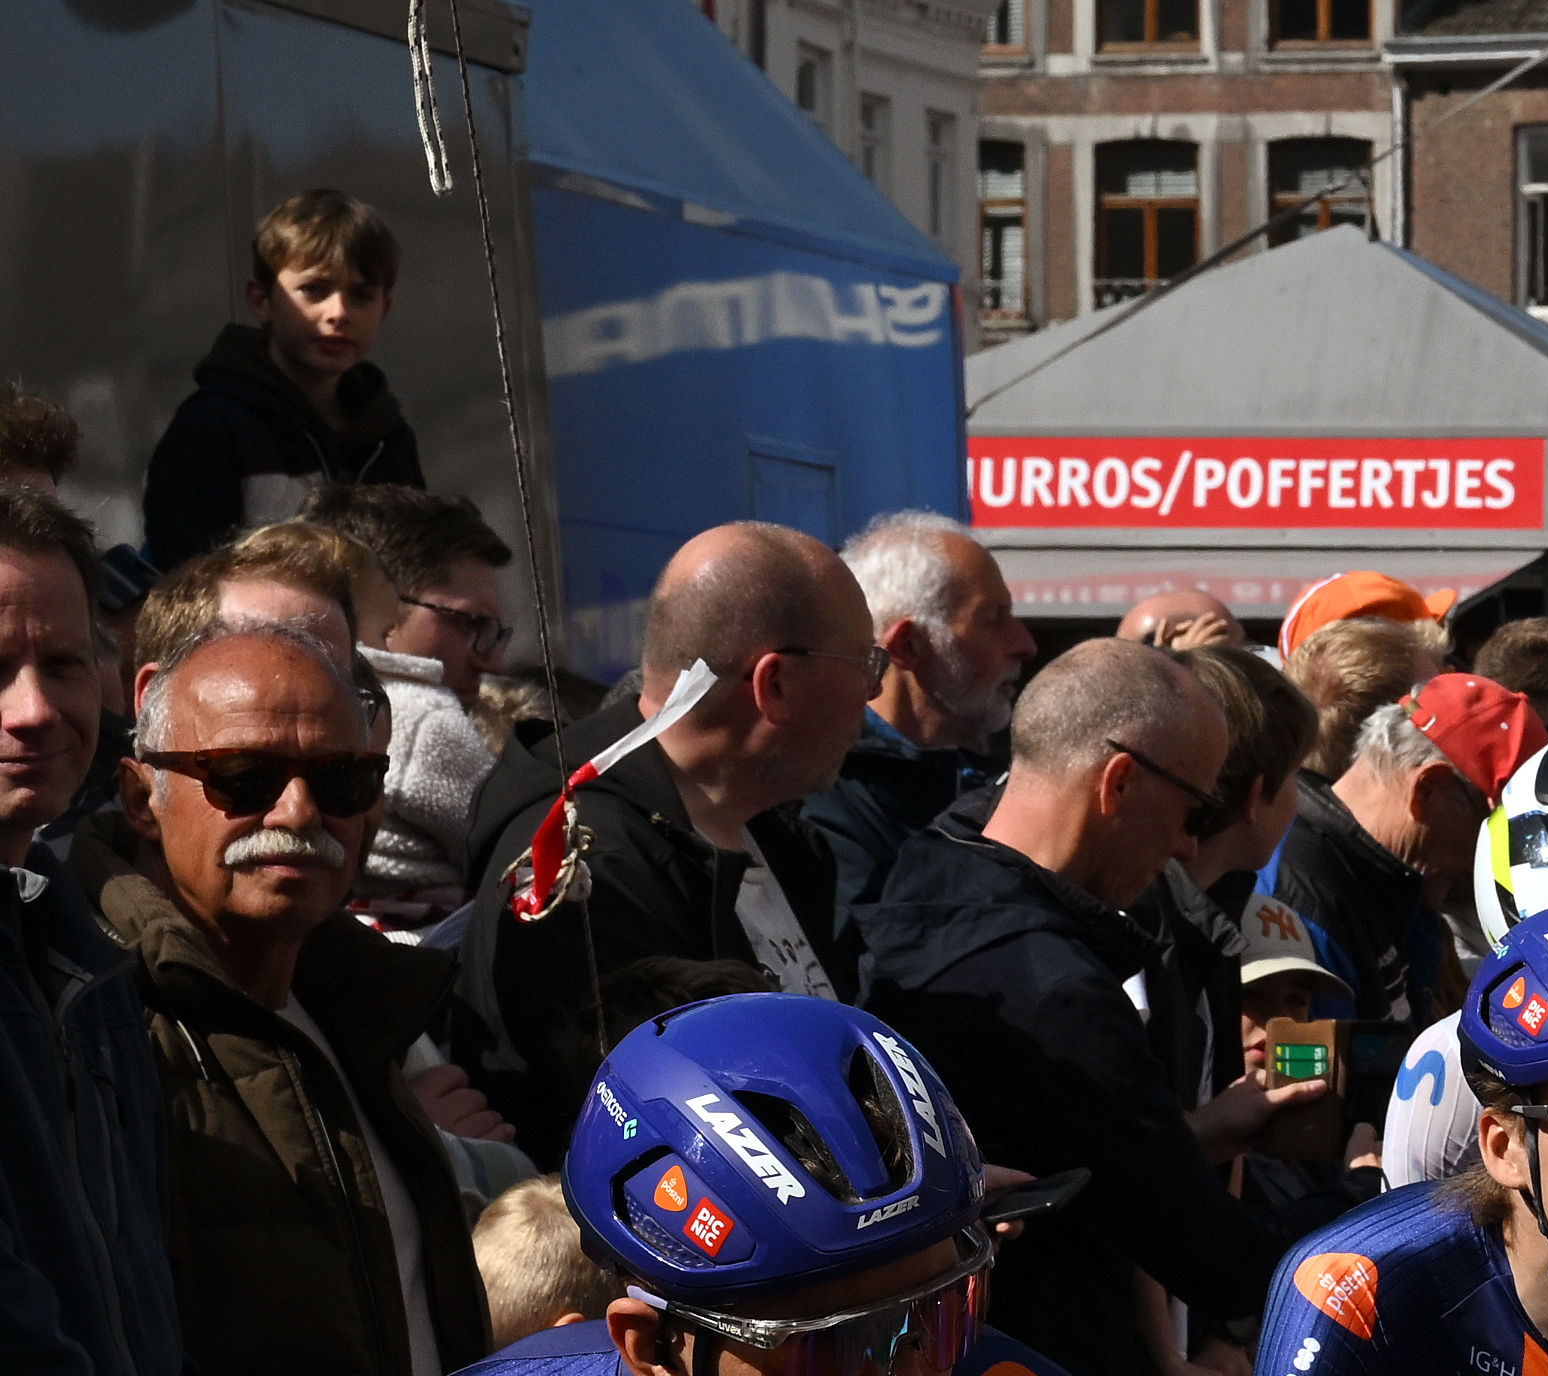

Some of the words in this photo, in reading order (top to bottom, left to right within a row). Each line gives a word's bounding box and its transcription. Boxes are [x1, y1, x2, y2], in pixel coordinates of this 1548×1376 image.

[872, 1029, 948, 1159] LAZER
[689, 1091, 807, 1207] LAZER
[856, 1193, 921, 1231] LAZER
[718, 1321, 742, 1337] uvex
